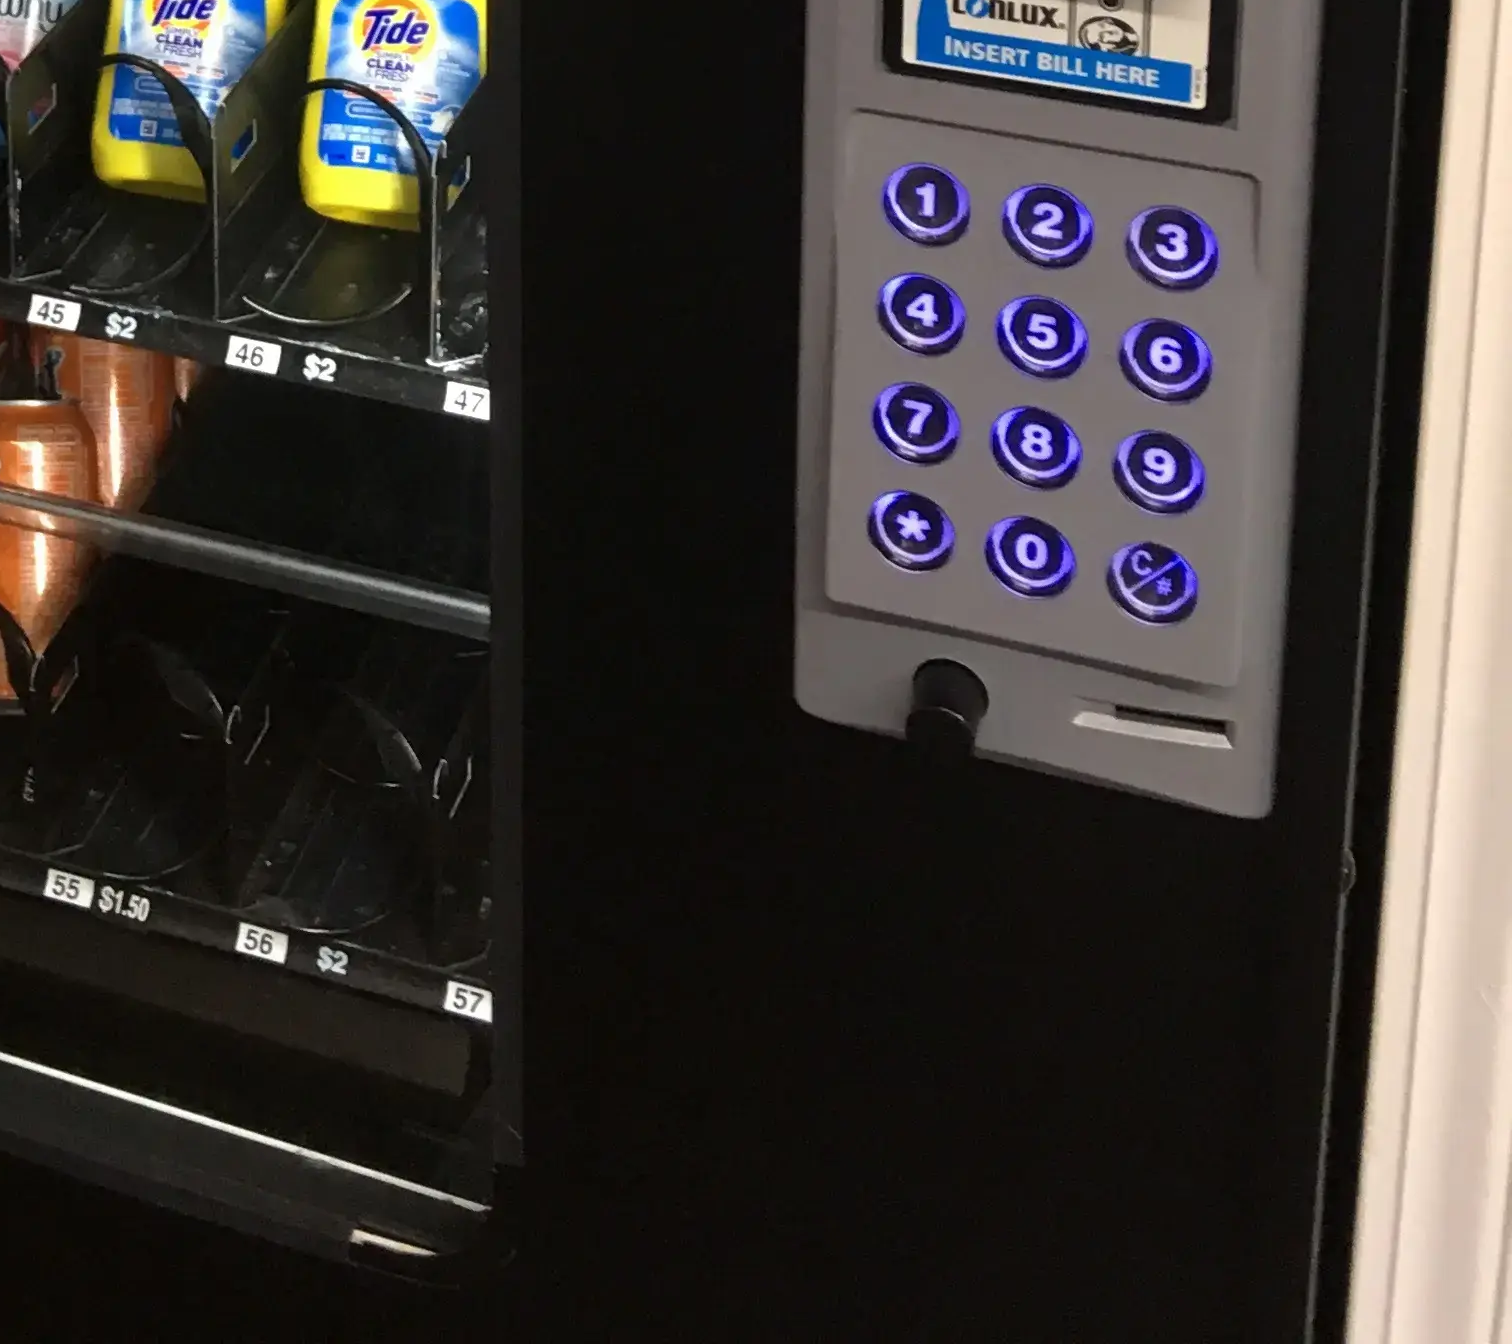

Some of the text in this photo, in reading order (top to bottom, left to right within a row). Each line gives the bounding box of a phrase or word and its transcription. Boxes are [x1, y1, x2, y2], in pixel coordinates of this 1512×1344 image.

[155, 33, 204, 48] CLEAN
[361, 8, 430, 51] Tide
[366, 57, 416, 73] CLEAN
[944, 35, 1161, 88] INSERT BILL HERE
[915, 182, 936, 217] 1
[1032, 202, 1064, 240] 2
[1155, 224, 1188, 261] 3
[36, 300, 138, 339] 45 $2
[906, 292, 938, 327] 4
[1026, 314, 1059, 350] 5
[235, 342, 337, 382] 46 $2
[1148, 337, 1182, 373] 6
[453, 389, 486, 411] 47
[902, 399, 933, 435] 7
[1020, 424, 1053, 461] 8
[1141, 447, 1176, 484] 9
[1014, 533, 1048, 570] 0
[51, 878, 150, 922] 55 $1.50
[243, 928, 349, 975] 56 $2
[452, 987, 485, 1013] 57
